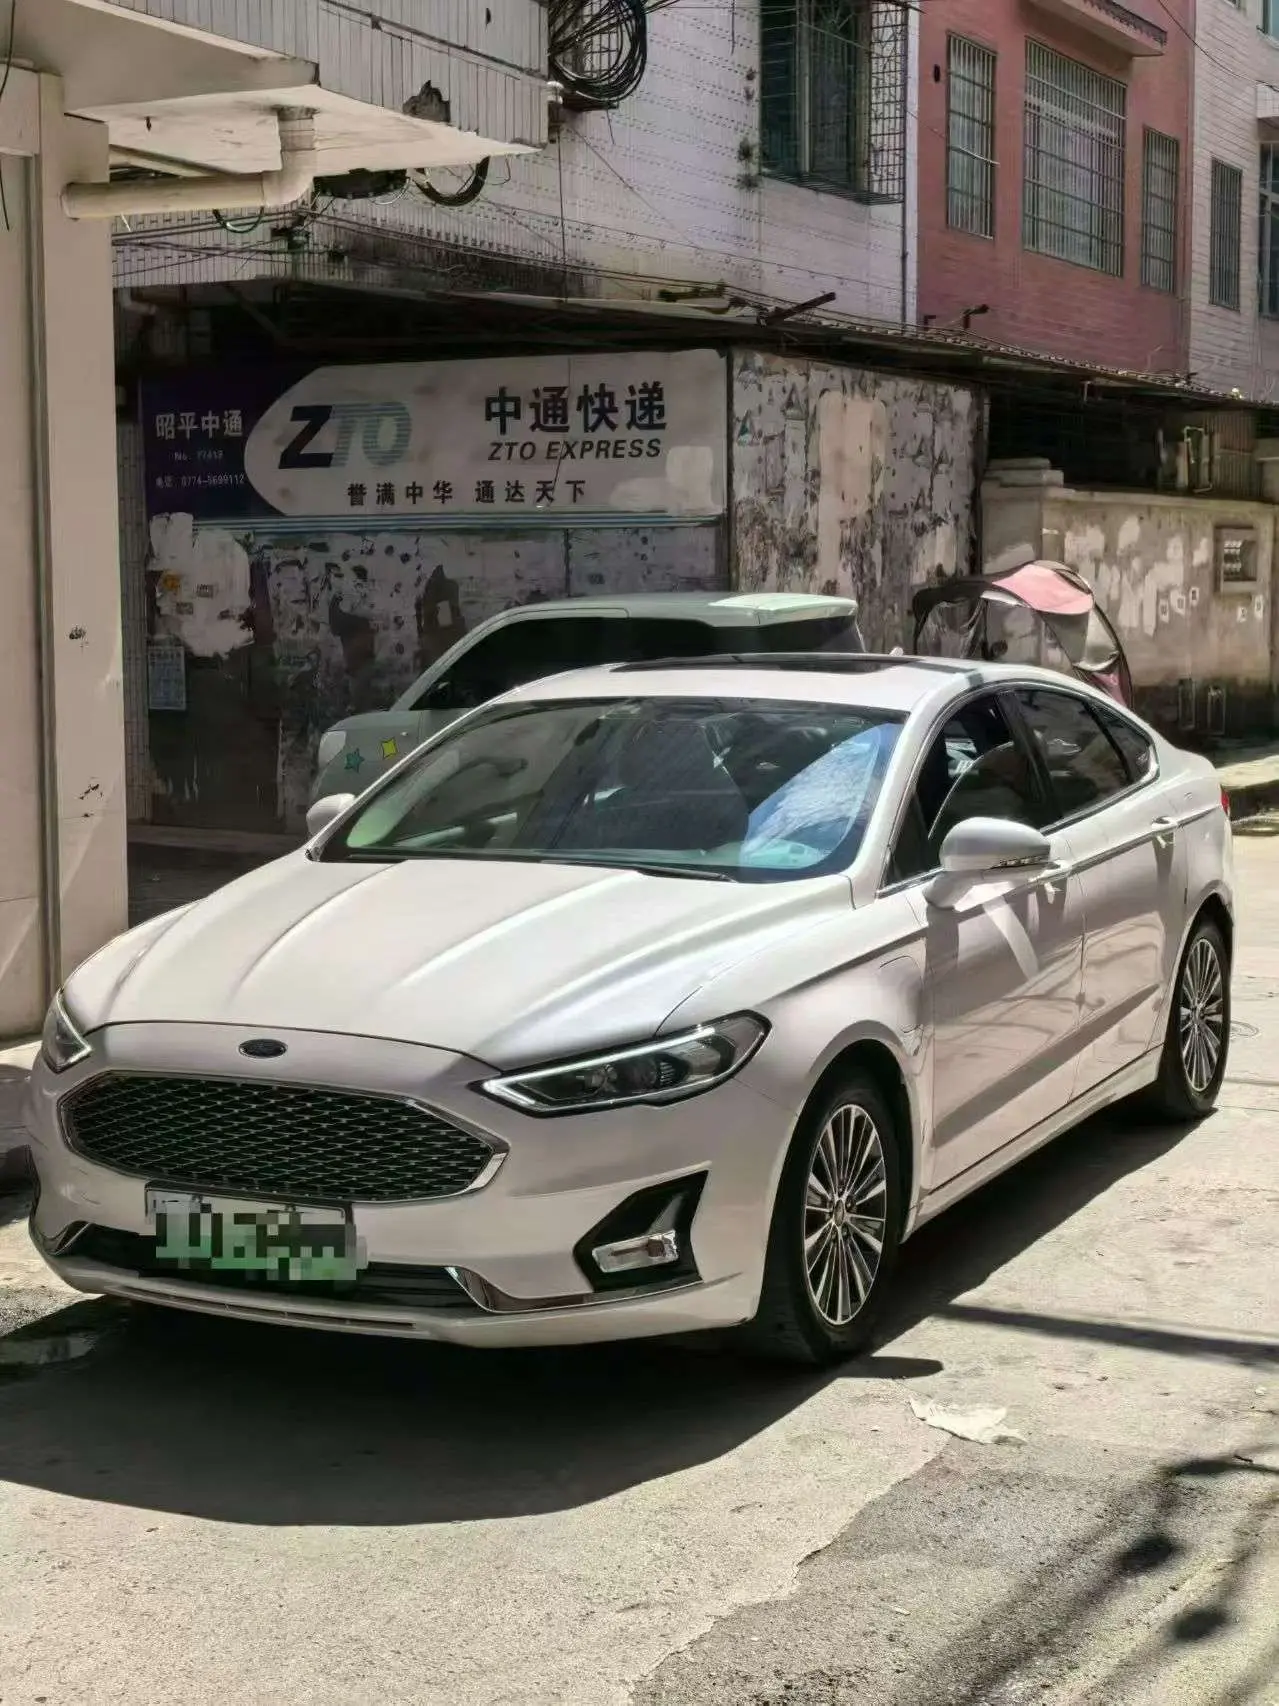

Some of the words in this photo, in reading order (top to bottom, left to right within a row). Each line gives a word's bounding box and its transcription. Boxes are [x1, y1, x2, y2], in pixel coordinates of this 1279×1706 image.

[485, 381, 667, 436] 中通快递
[156, 409, 243, 441] 昭平中通
[278, 403, 411, 470] ZTO
[488, 441, 536, 461] ZTO
[547, 438, 662, 460] EXPRESS
[475, 480, 587, 505] 通达天下
